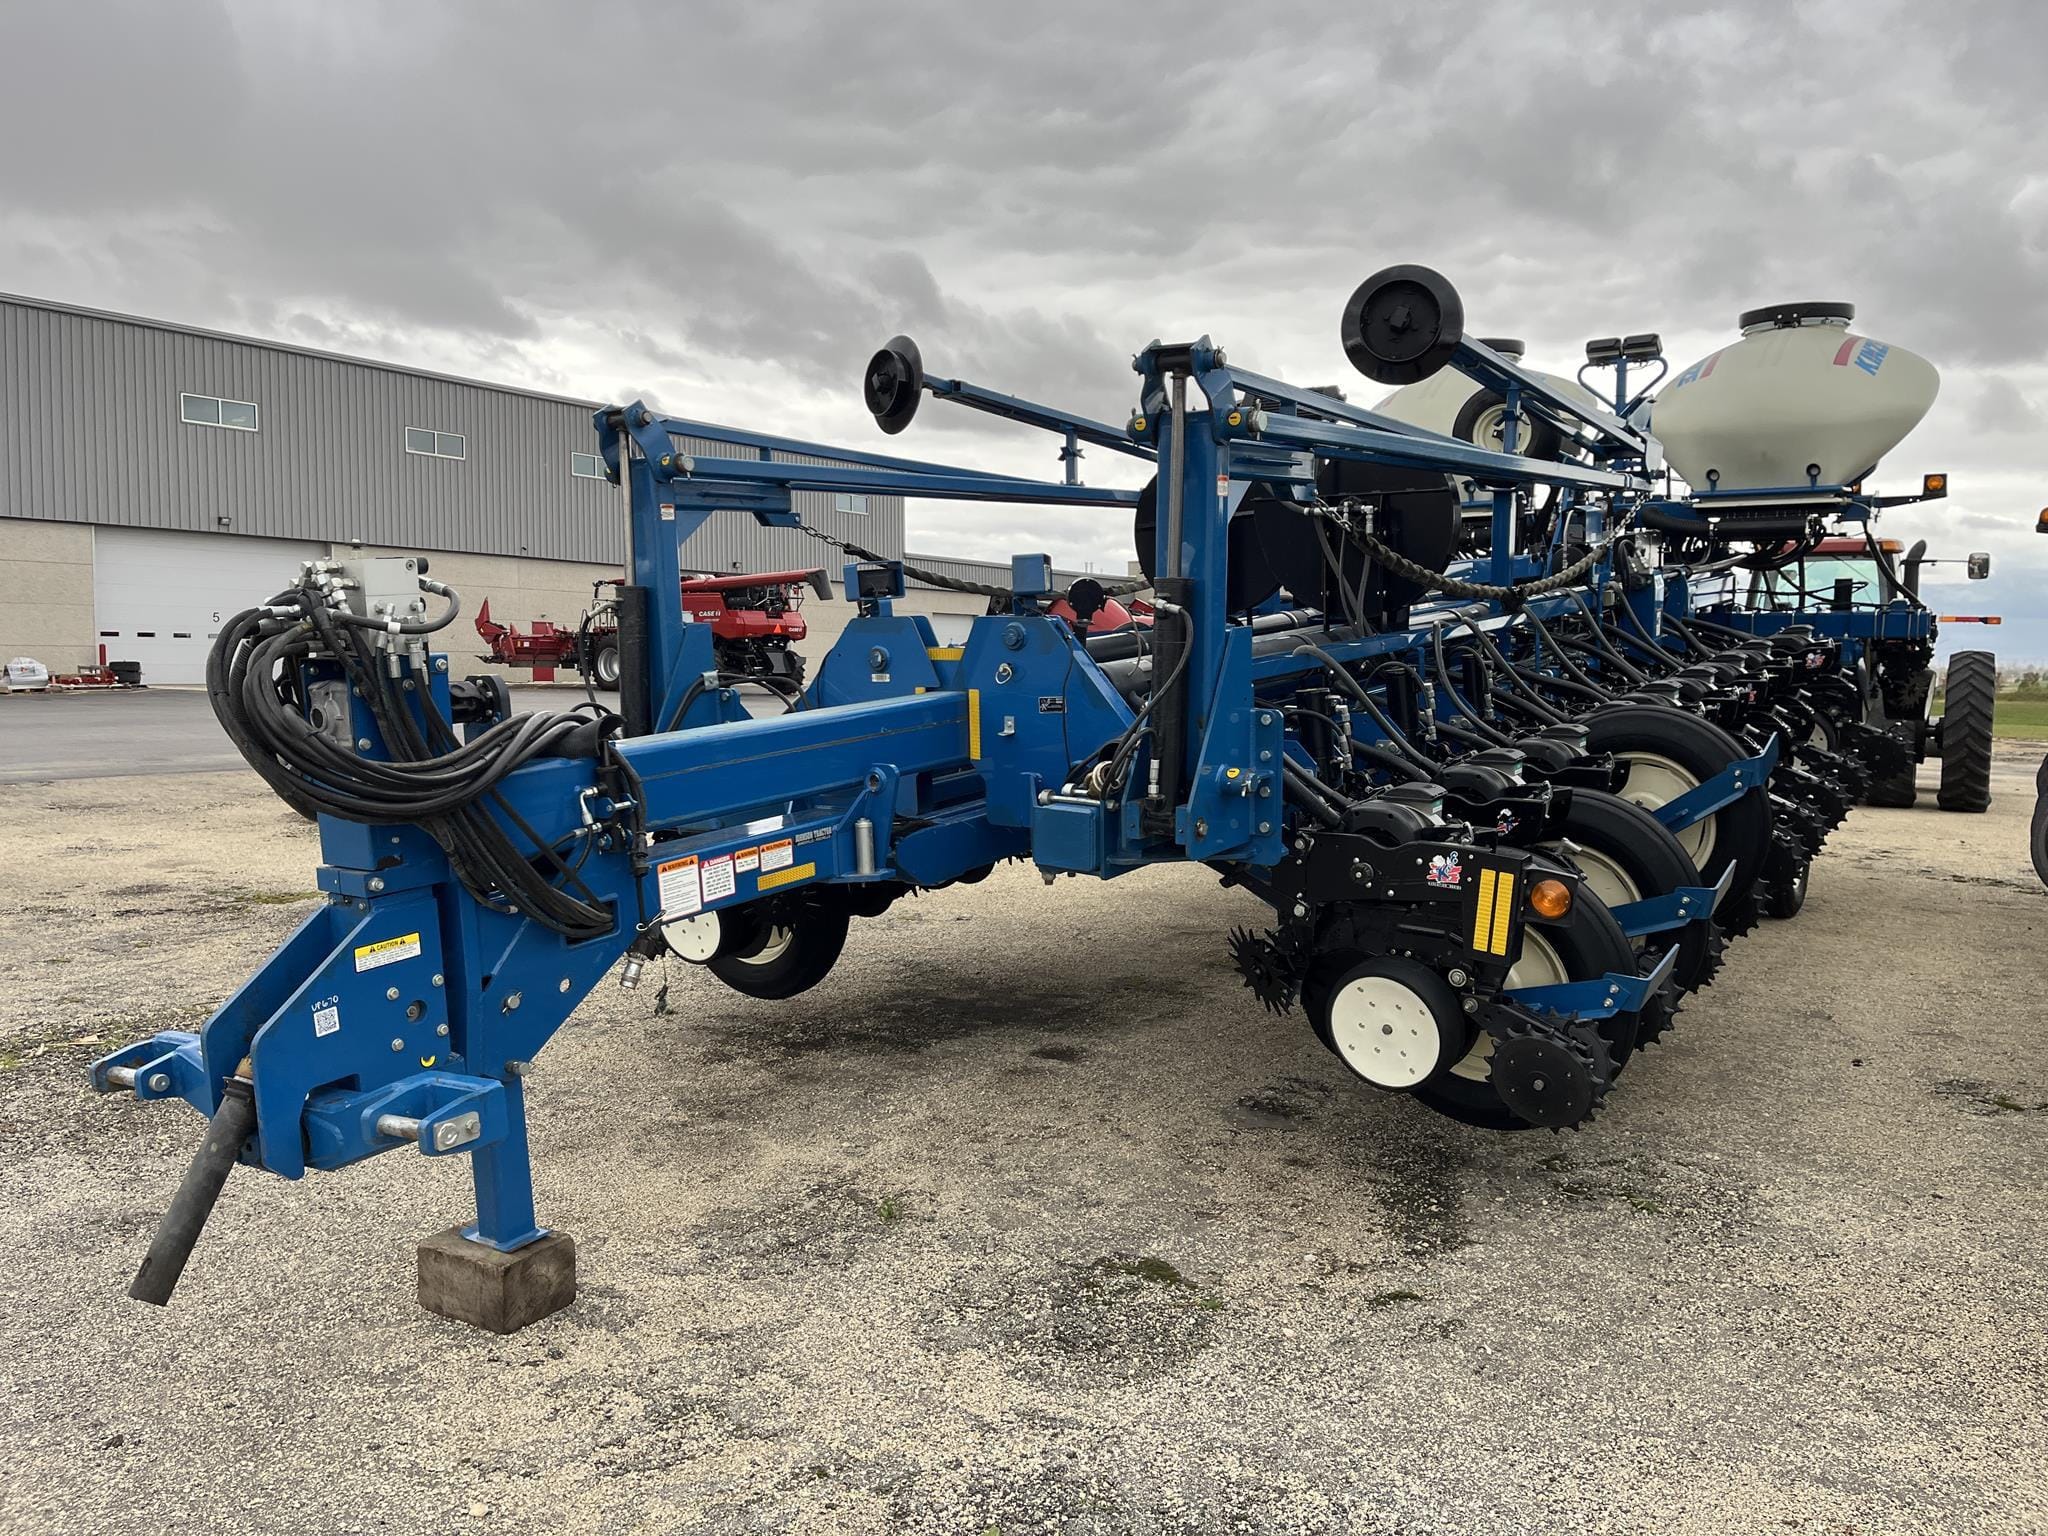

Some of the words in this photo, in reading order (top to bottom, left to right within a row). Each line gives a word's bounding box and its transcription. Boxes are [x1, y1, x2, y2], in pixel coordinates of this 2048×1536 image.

[1854, 338, 1889, 376] KINZ
[212, 612, 220, 623] 5
[699, 609, 714, 617] CASE
[766, 841, 787, 852] WARNING
[667, 860, 690, 872] WARNING
[709, 855, 731, 867] DANGER
[376, 941, 399, 951] CAUTION
[311, 995, 339, 1012] UP670
